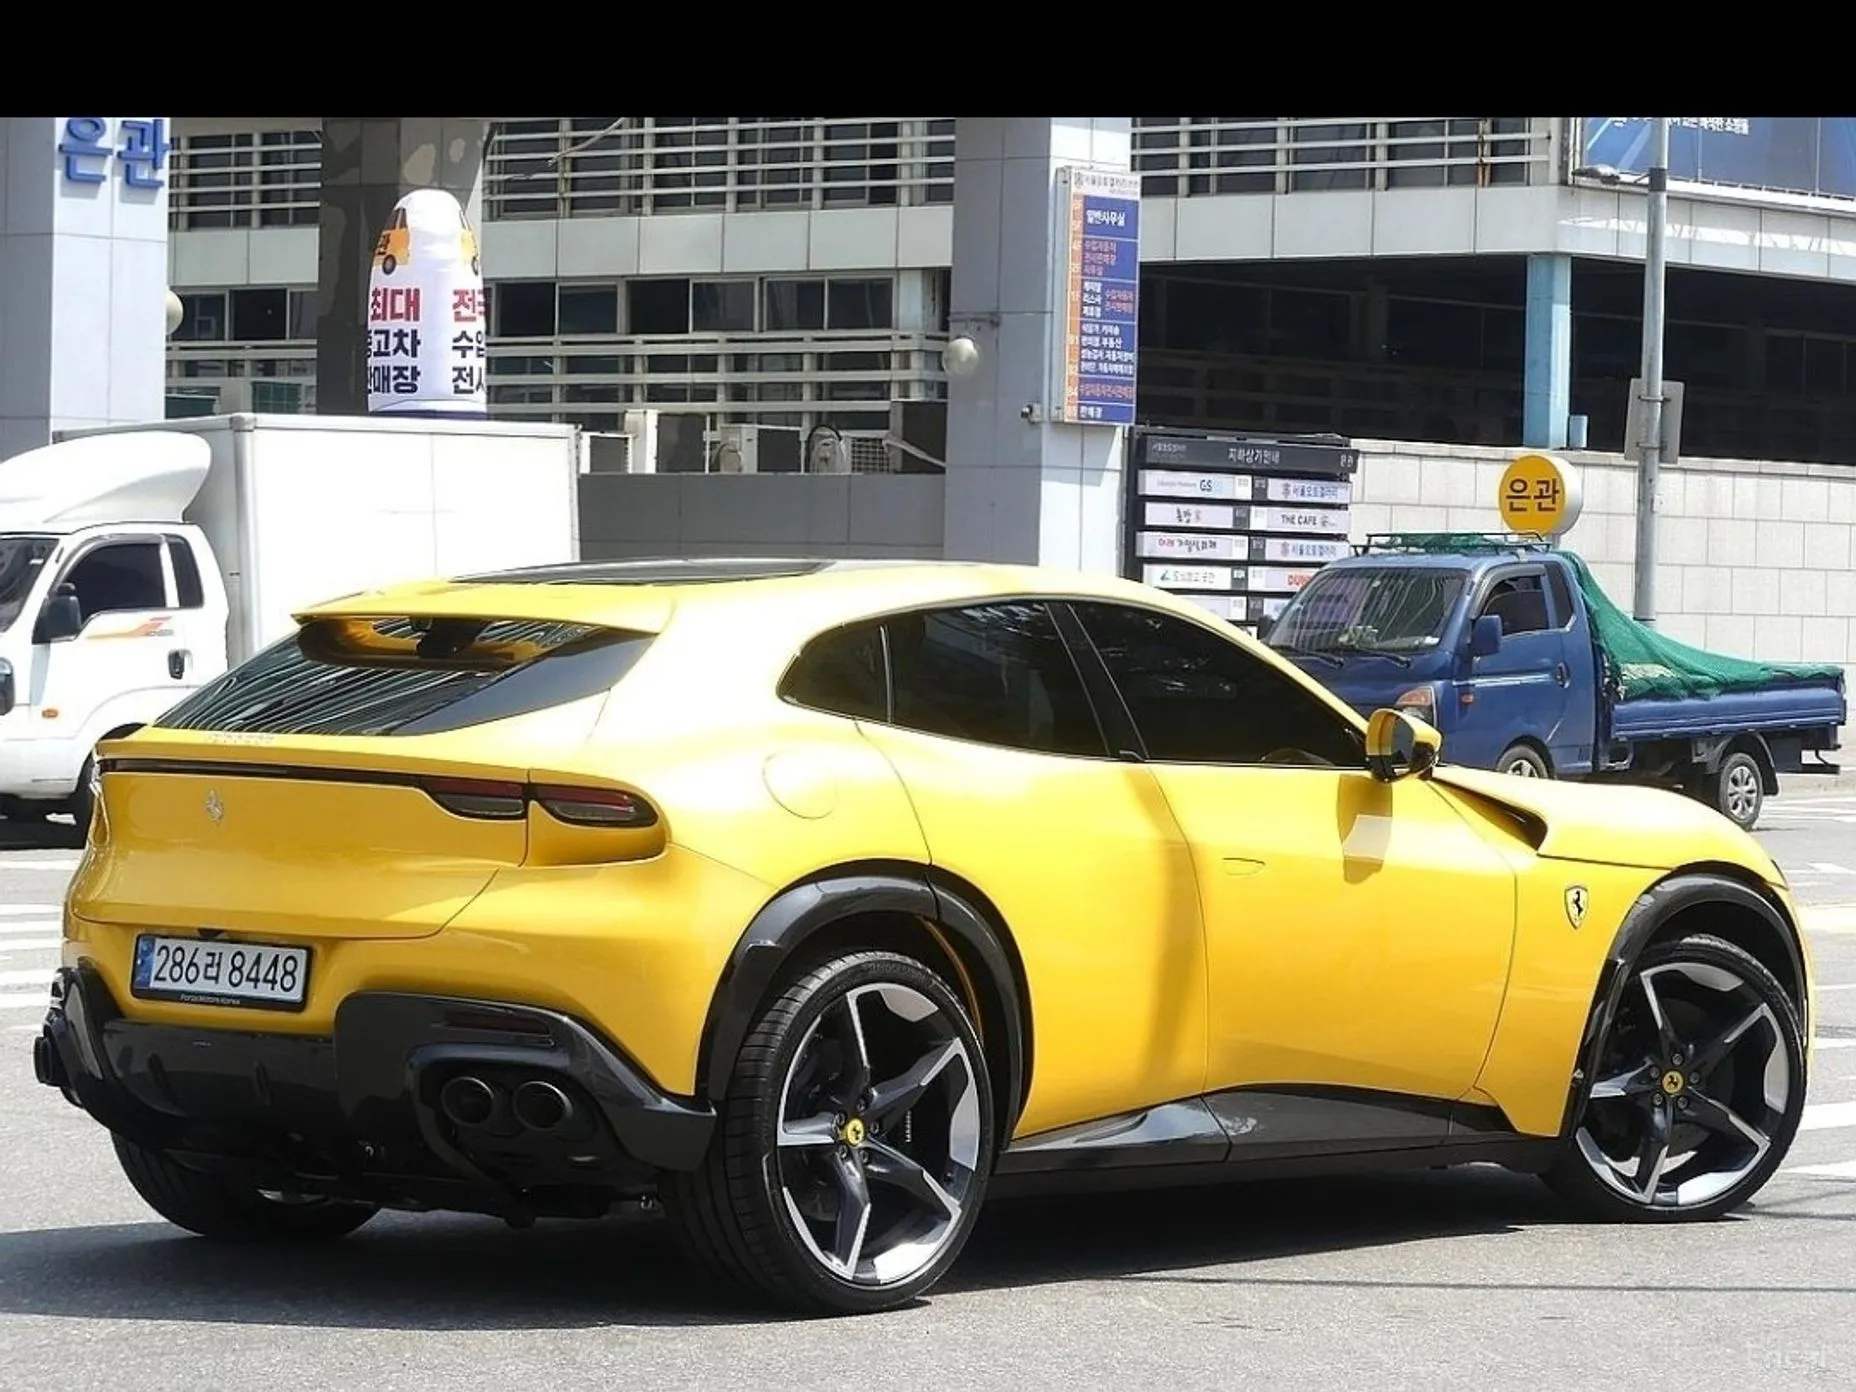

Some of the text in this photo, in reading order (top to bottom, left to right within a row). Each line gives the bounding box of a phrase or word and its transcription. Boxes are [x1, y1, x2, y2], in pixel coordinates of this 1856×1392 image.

[59, 117, 170, 188] 은관
[370, 287, 421, 322] 최대
[1506, 478, 1560, 512] 은관
[1297, 514, 1318, 526] CAFE
[153, 944, 299, 993] 286러 8448
